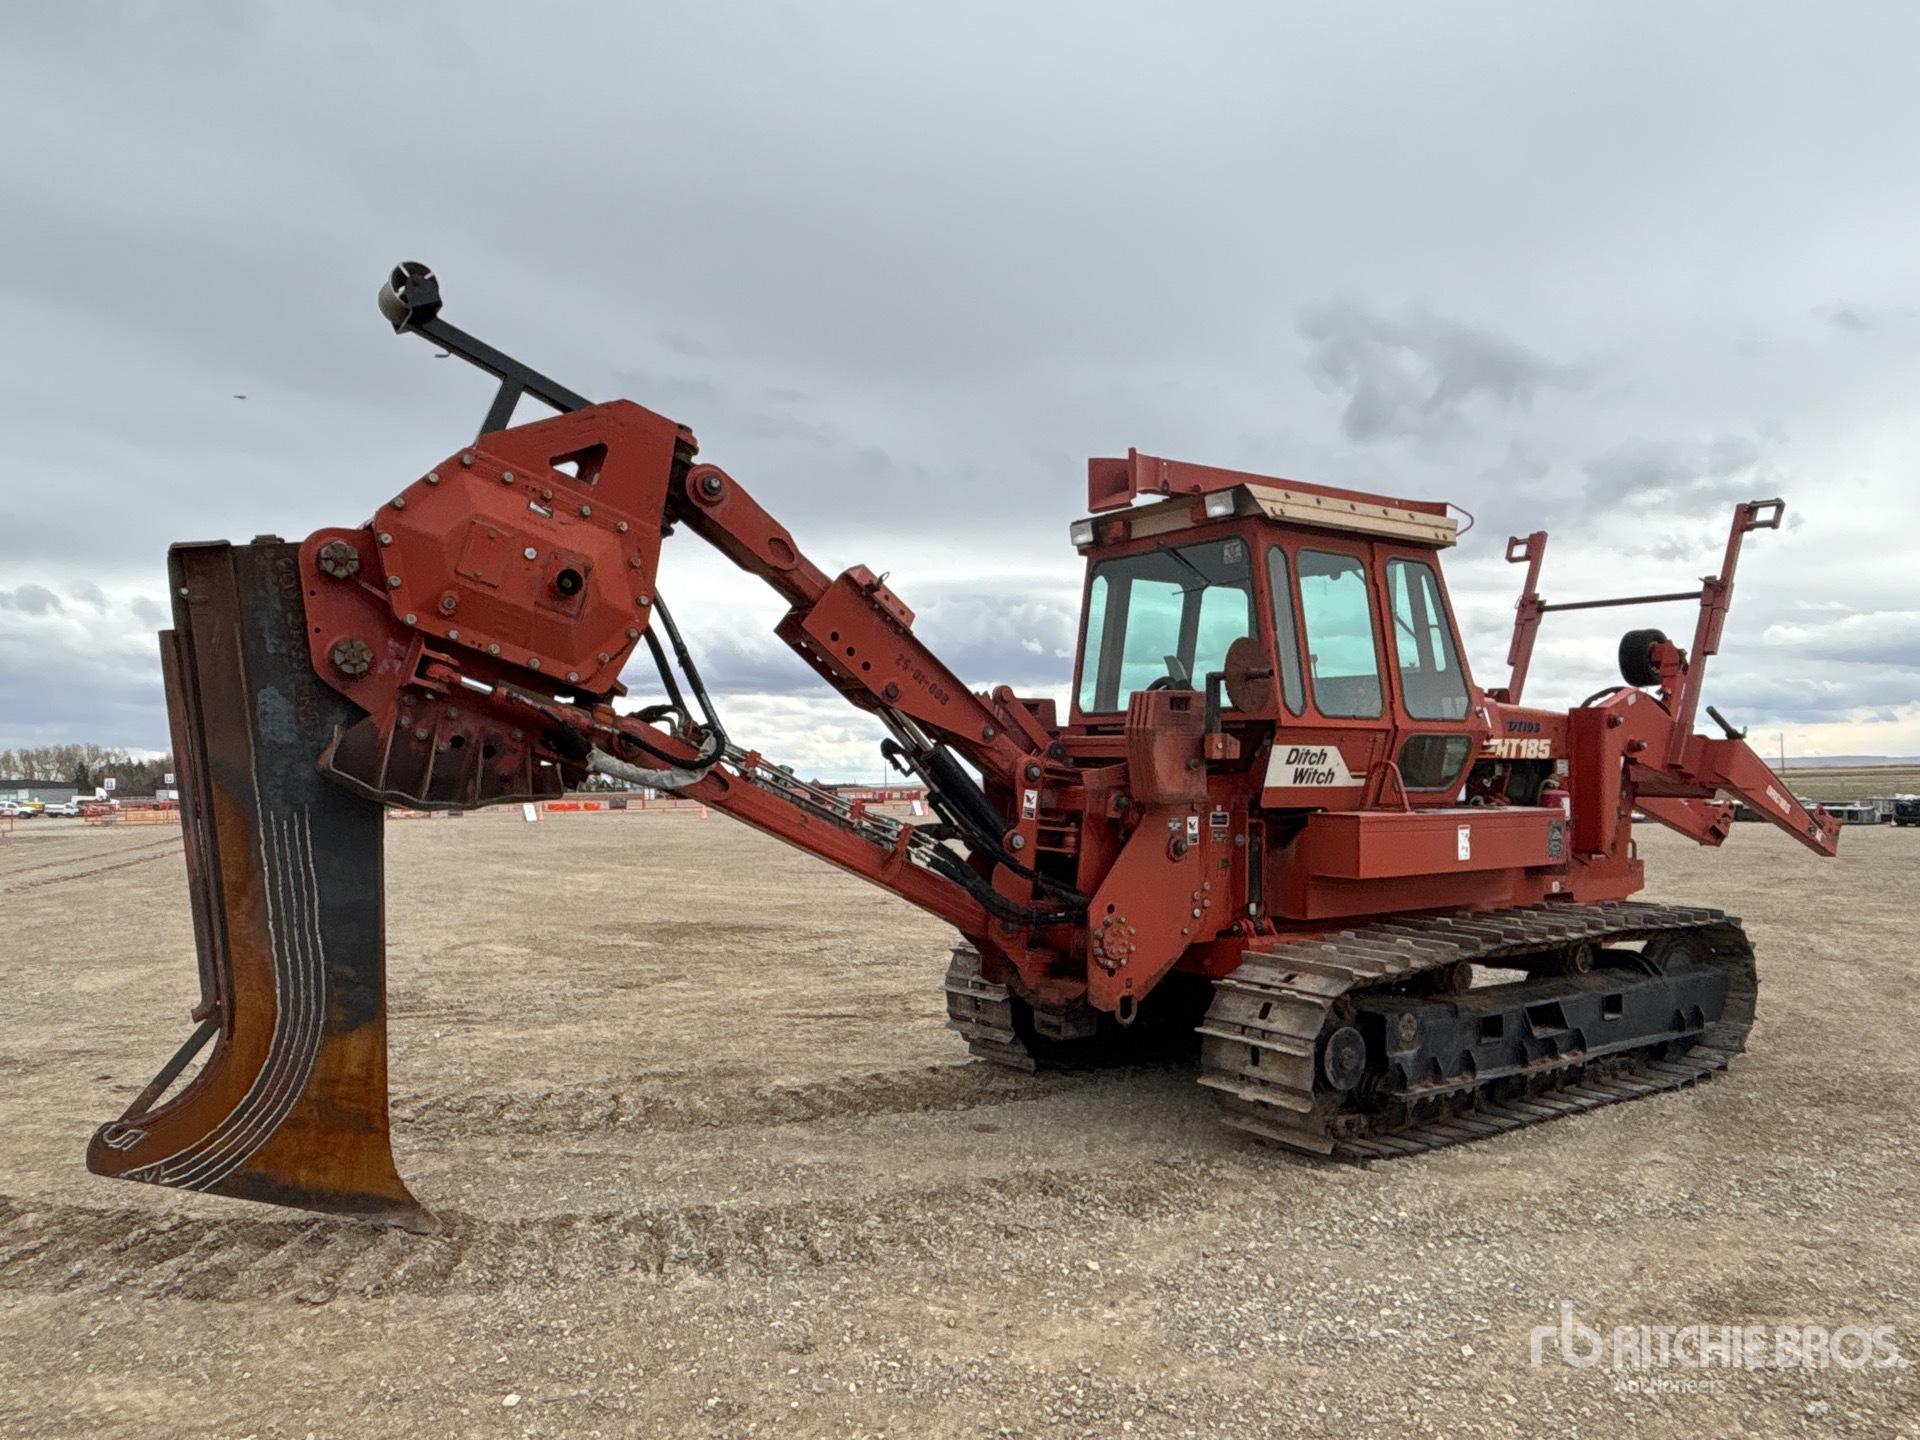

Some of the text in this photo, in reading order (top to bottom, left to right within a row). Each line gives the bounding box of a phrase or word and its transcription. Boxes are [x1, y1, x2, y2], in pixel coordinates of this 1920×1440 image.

[1285, 747, 1328, 766] Ditch
[1494, 738, 1552, 759] HT185
[1291, 767, 1336, 785] Witch
